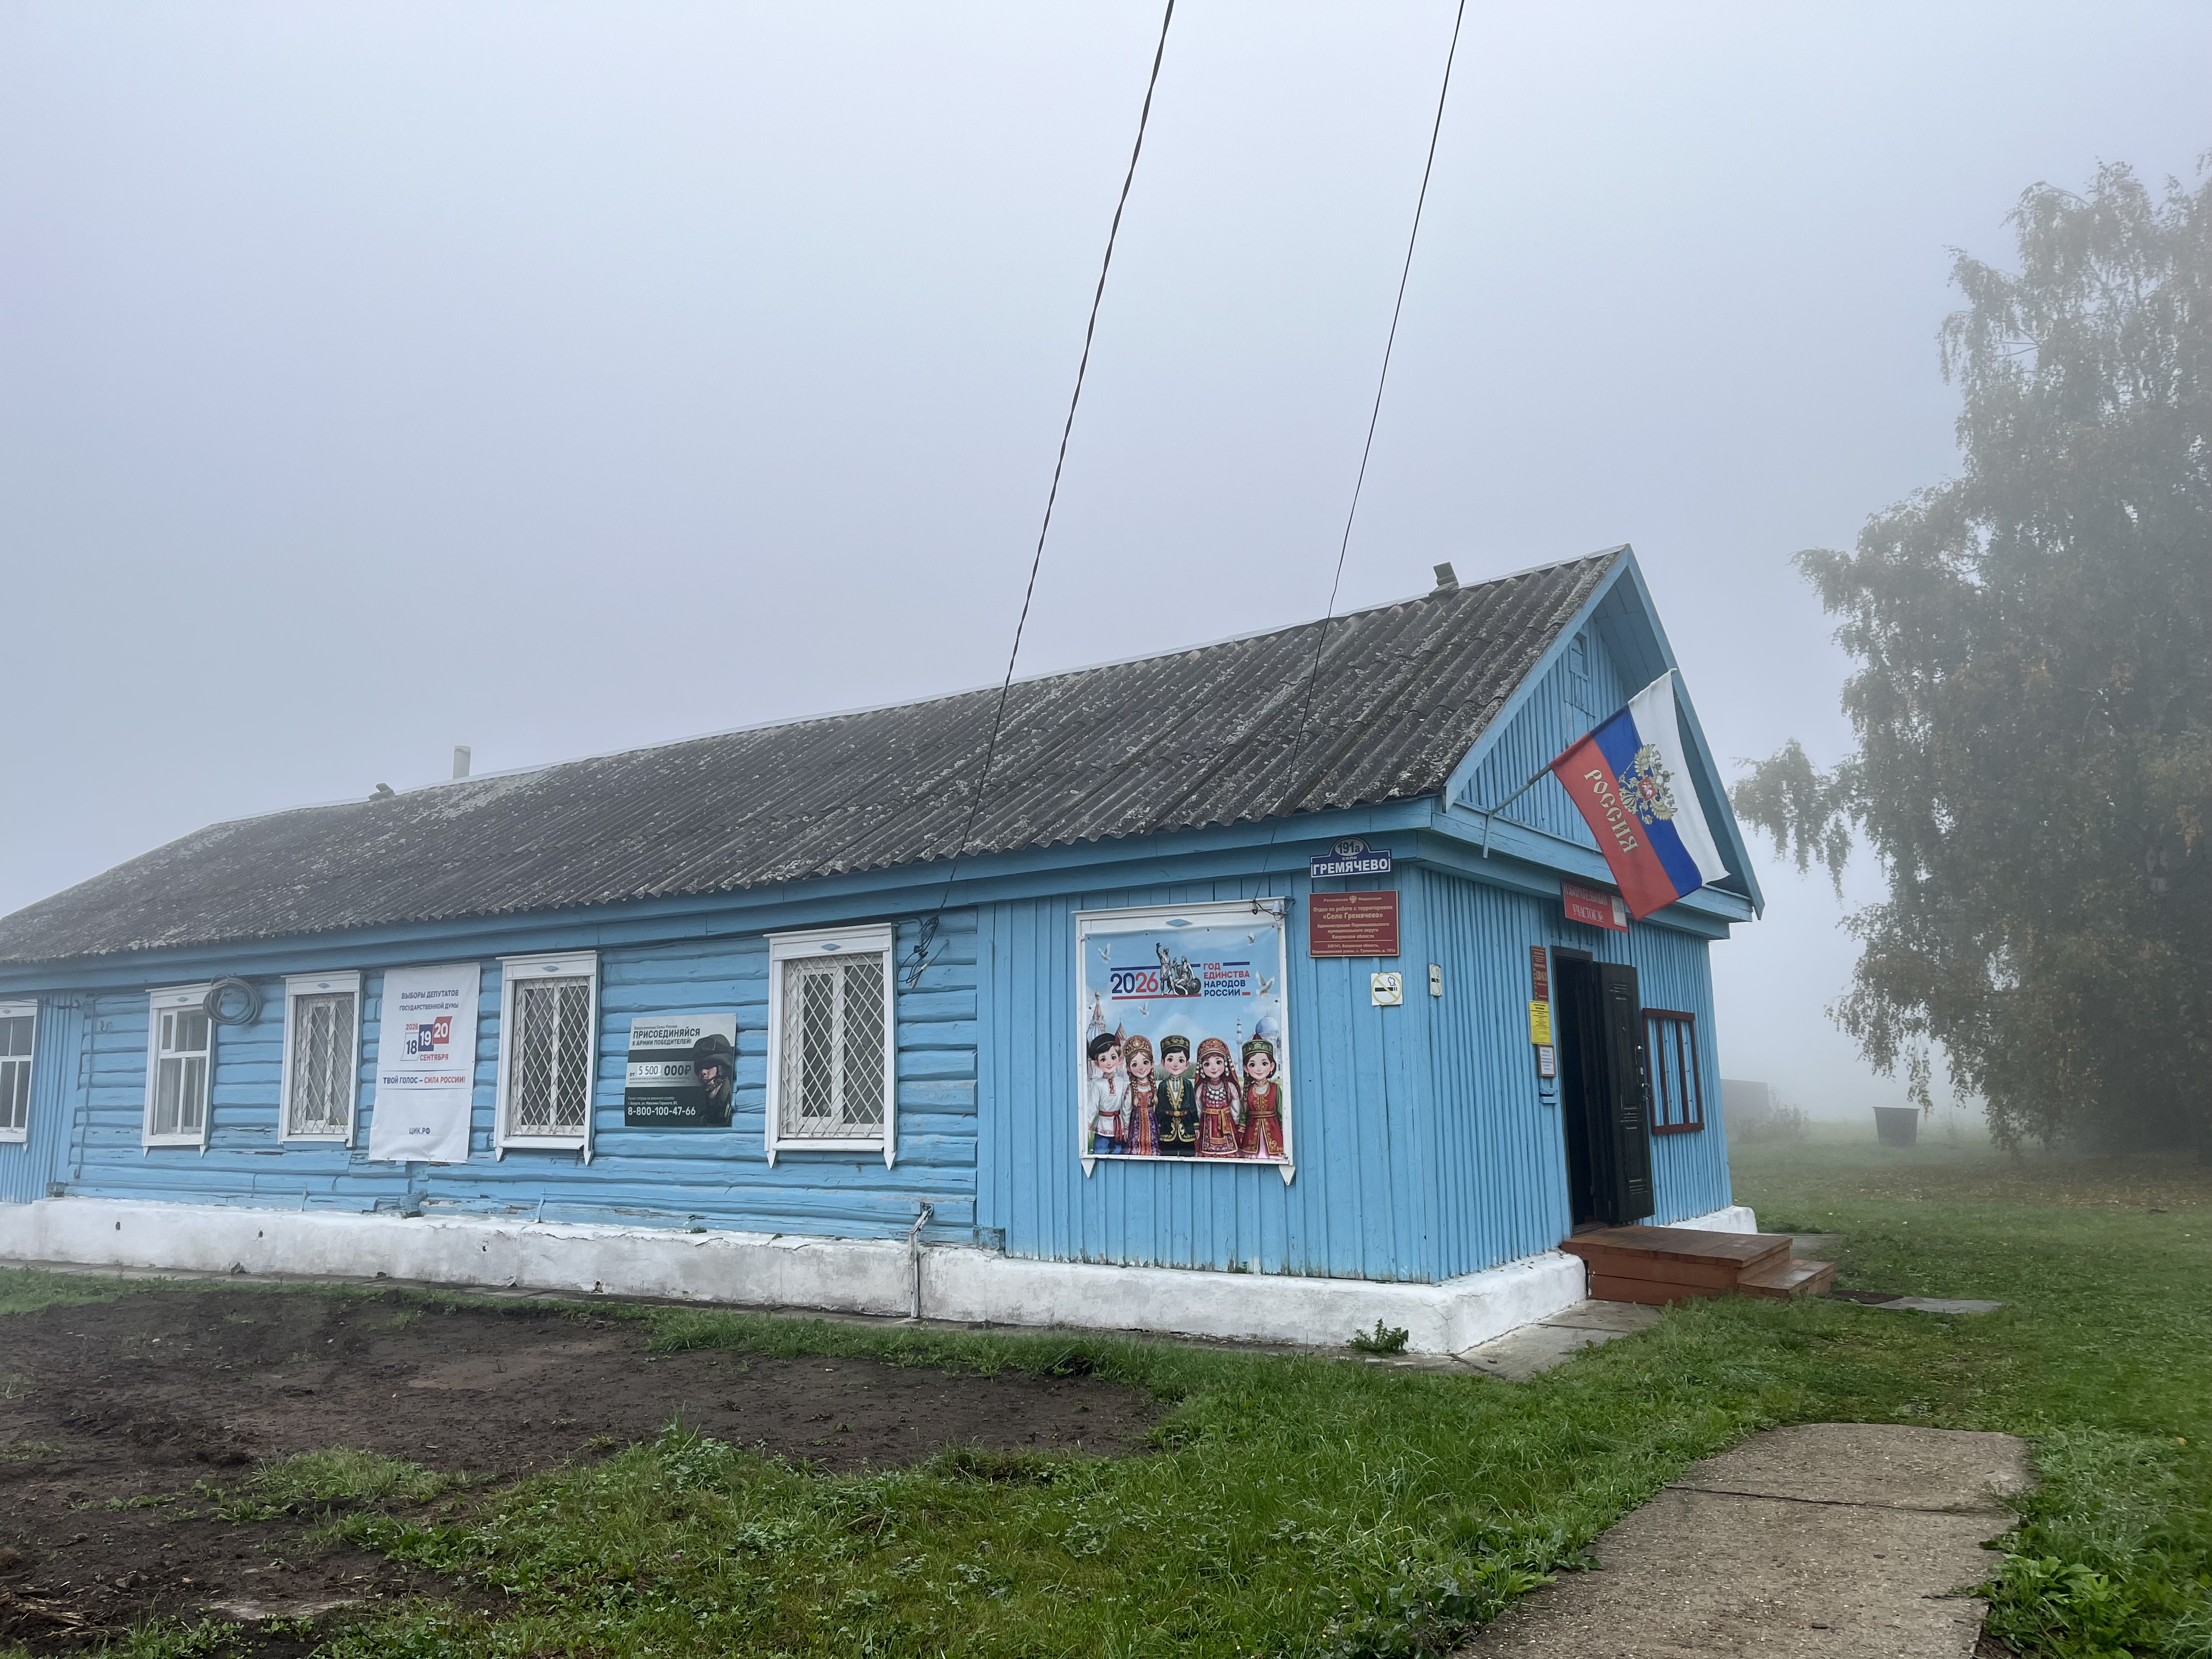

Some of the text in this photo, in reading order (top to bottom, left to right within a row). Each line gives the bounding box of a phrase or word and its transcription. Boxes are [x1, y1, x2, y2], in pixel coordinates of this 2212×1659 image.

[1583, 769, 1639, 854] РОССИЯ
[1338, 841, 1360, 854] 191а
[1313, 858, 1388, 875] ГРЕМЯЧЕВО
[1344, 912, 1383, 921] Гремячево»
[1572, 903, 1597, 921] УЧАСТОК
[1597, 910, 1604, 923] №
[1203, 962, 1221, 970] ГОД
[1203, 970, 1250, 980] ЕДИНСТВА
[1110, 972, 1159, 994] 2026
[1204, 979, 1246, 989] НАРОДОВ
[426, 990, 459, 999] ДЕПУТАТОВ
[1204, 989, 1240, 997] РОССИИ
[399, 1002, 444, 1011] ГОСУДАРСТВЕННОЙ
[633, 1026, 701, 1039] ПРИСОЕДИНЯЙСЯ
[406, 1022, 448, 1054] 18 19 20
[638, 1066, 643, 1075] 5
[645, 1065, 658, 1075] 500
[383, 1075, 398, 1084] ТВОЙ
[627, 1106, 696, 1116] 8-800-100-47-66
[409, 1127, 431, 1135] ЦИК.РФ
